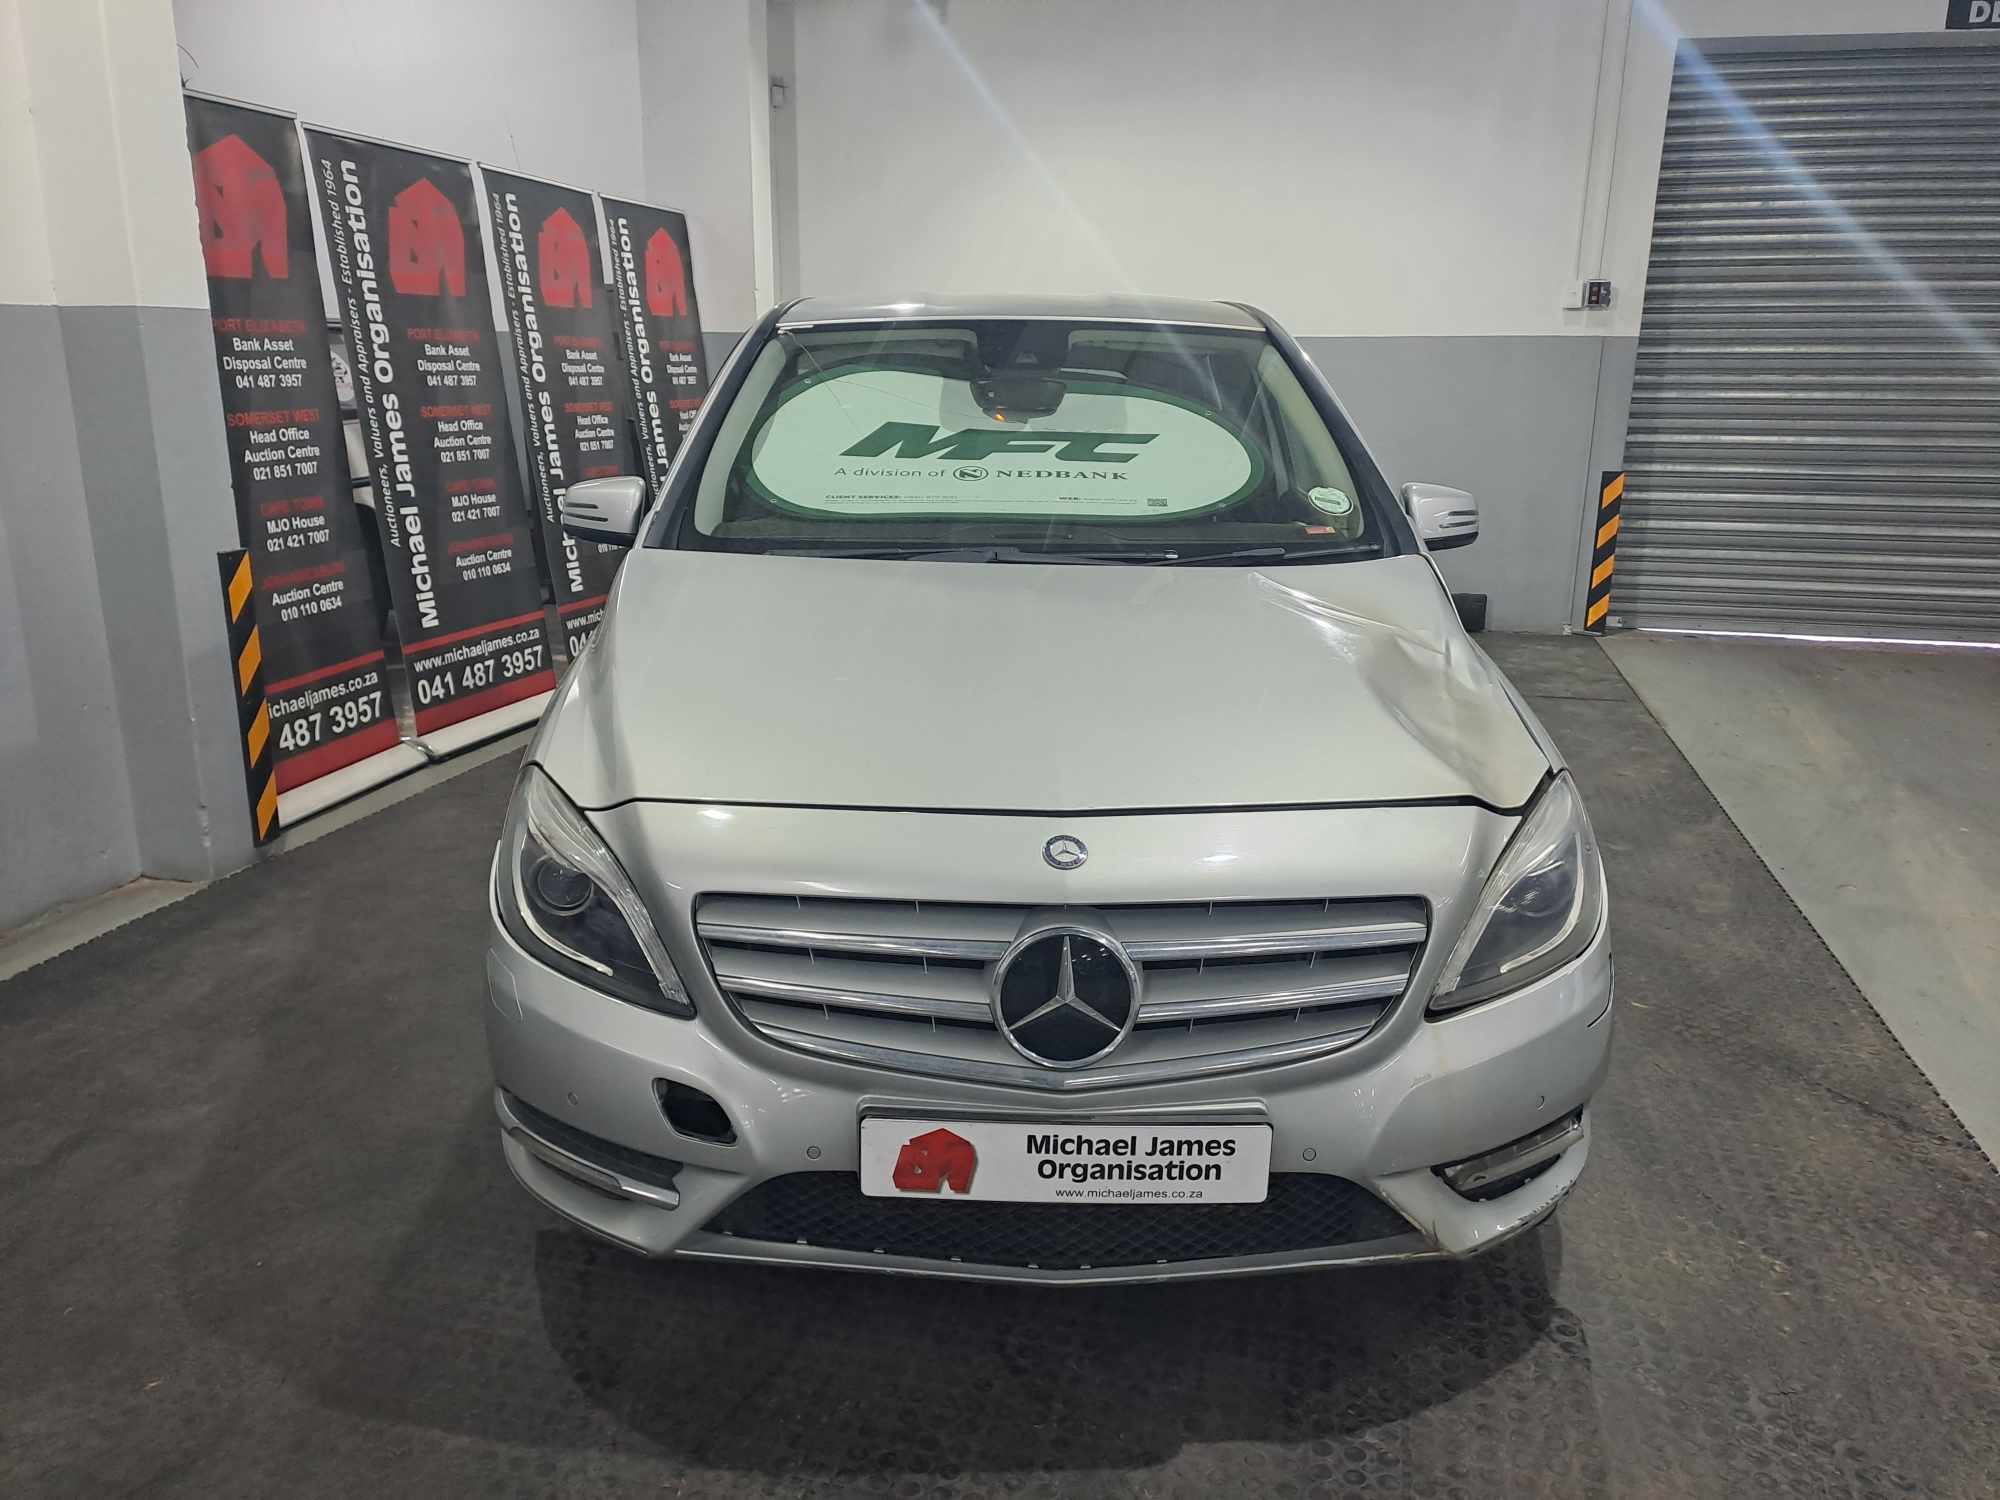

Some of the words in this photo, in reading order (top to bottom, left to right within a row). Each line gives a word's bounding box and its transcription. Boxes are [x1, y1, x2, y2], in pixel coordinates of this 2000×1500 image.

[321, 158, 337, 198] 1964
[327, 200, 352, 285] Established
[341, 160, 394, 384] Organisation
[505, 192, 547, 383] Organisation
[618, 218, 653, 384] Organisation
[233, 337, 261, 351] Bank
[264, 338, 294, 351] Asset
[348, 297, 370, 375] Appraisers
[425, 344, 446, 355] Bank
[449, 345, 470, 356] Asset
[223, 356, 271, 373] Disposal
[274, 356, 307, 369] Centre
[417, 360, 455, 373] Disposal
[456, 360, 480, 371] Centre
[236, 376, 254, 388] 041
[257, 375, 276, 387] 487
[279, 374, 302, 386] 3957
[361, 376, 375, 403] and
[427, 376, 441, 386] 041
[250, 430, 276, 444] Head
[279, 428, 309, 441] Office
[367, 407, 384, 459] Valuers
[438, 421, 459, 432] Head
[460, 420, 483, 431] Office
[538, 391, 564, 480] James
[647, 391, 668, 469] James
[244, 447, 285, 463] Auction
[288, 445, 320, 458] Centre
[382, 392, 416, 498] James
[434, 436, 465, 448] Auction
[467, 435, 491, 445] Centre
[839, 422, 1160, 463] MFC
[441, 452, 454, 463] 021
[253, 467, 271, 480] 021
[274, 464, 292, 477] 851
[295, 462, 317, 475] 7007
[835, 467, 847, 477] A
[853, 466, 922, 477] division
[927, 469, 947, 478] of
[996, 469, 1129, 481] NEDBANK
[378, 463, 400, 547] Auctioneers,
[452, 495, 469, 507] MJO
[470, 493, 496, 504] House
[267, 518, 289, 533] MJO
[292, 515, 325, 529] House
[452, 511, 466, 522] 021
[467, 509, 480, 520] 421
[267, 538, 284, 552] 021
[287, 533, 305, 547] 421
[308, 529, 329, 545] 7007
[400, 506, 440, 629] Michael
[456, 554, 485, 567] Auction
[487, 549, 512, 560] Centre
[463, 569, 476, 580] 010
[478, 566, 490, 577] 110
[272, 587, 310, 606] Auction
[313, 580, 344, 596] Centre
[281, 606, 298, 622] 010
[300, 601, 318, 617] 110
[320, 595, 342, 614] 0634
[414, 628, 539, 673] www.michaeljames.co.za
[417, 671, 455, 704] 041
[462, 659, 495, 689] 487
[501, 645, 543, 677] 3957
[267, 670, 378, 720] ichaeljames.co.za
[279, 713, 322, 751] 487
[329, 691, 382, 733] 3957
[1026, 1134, 1137, 1157] Michael
[1144, 1136, 1236, 1158] James
[1037, 1158, 1222, 1185] Organisation
[1055, 1188, 1203, 1201] www.michaeljames.co.za
